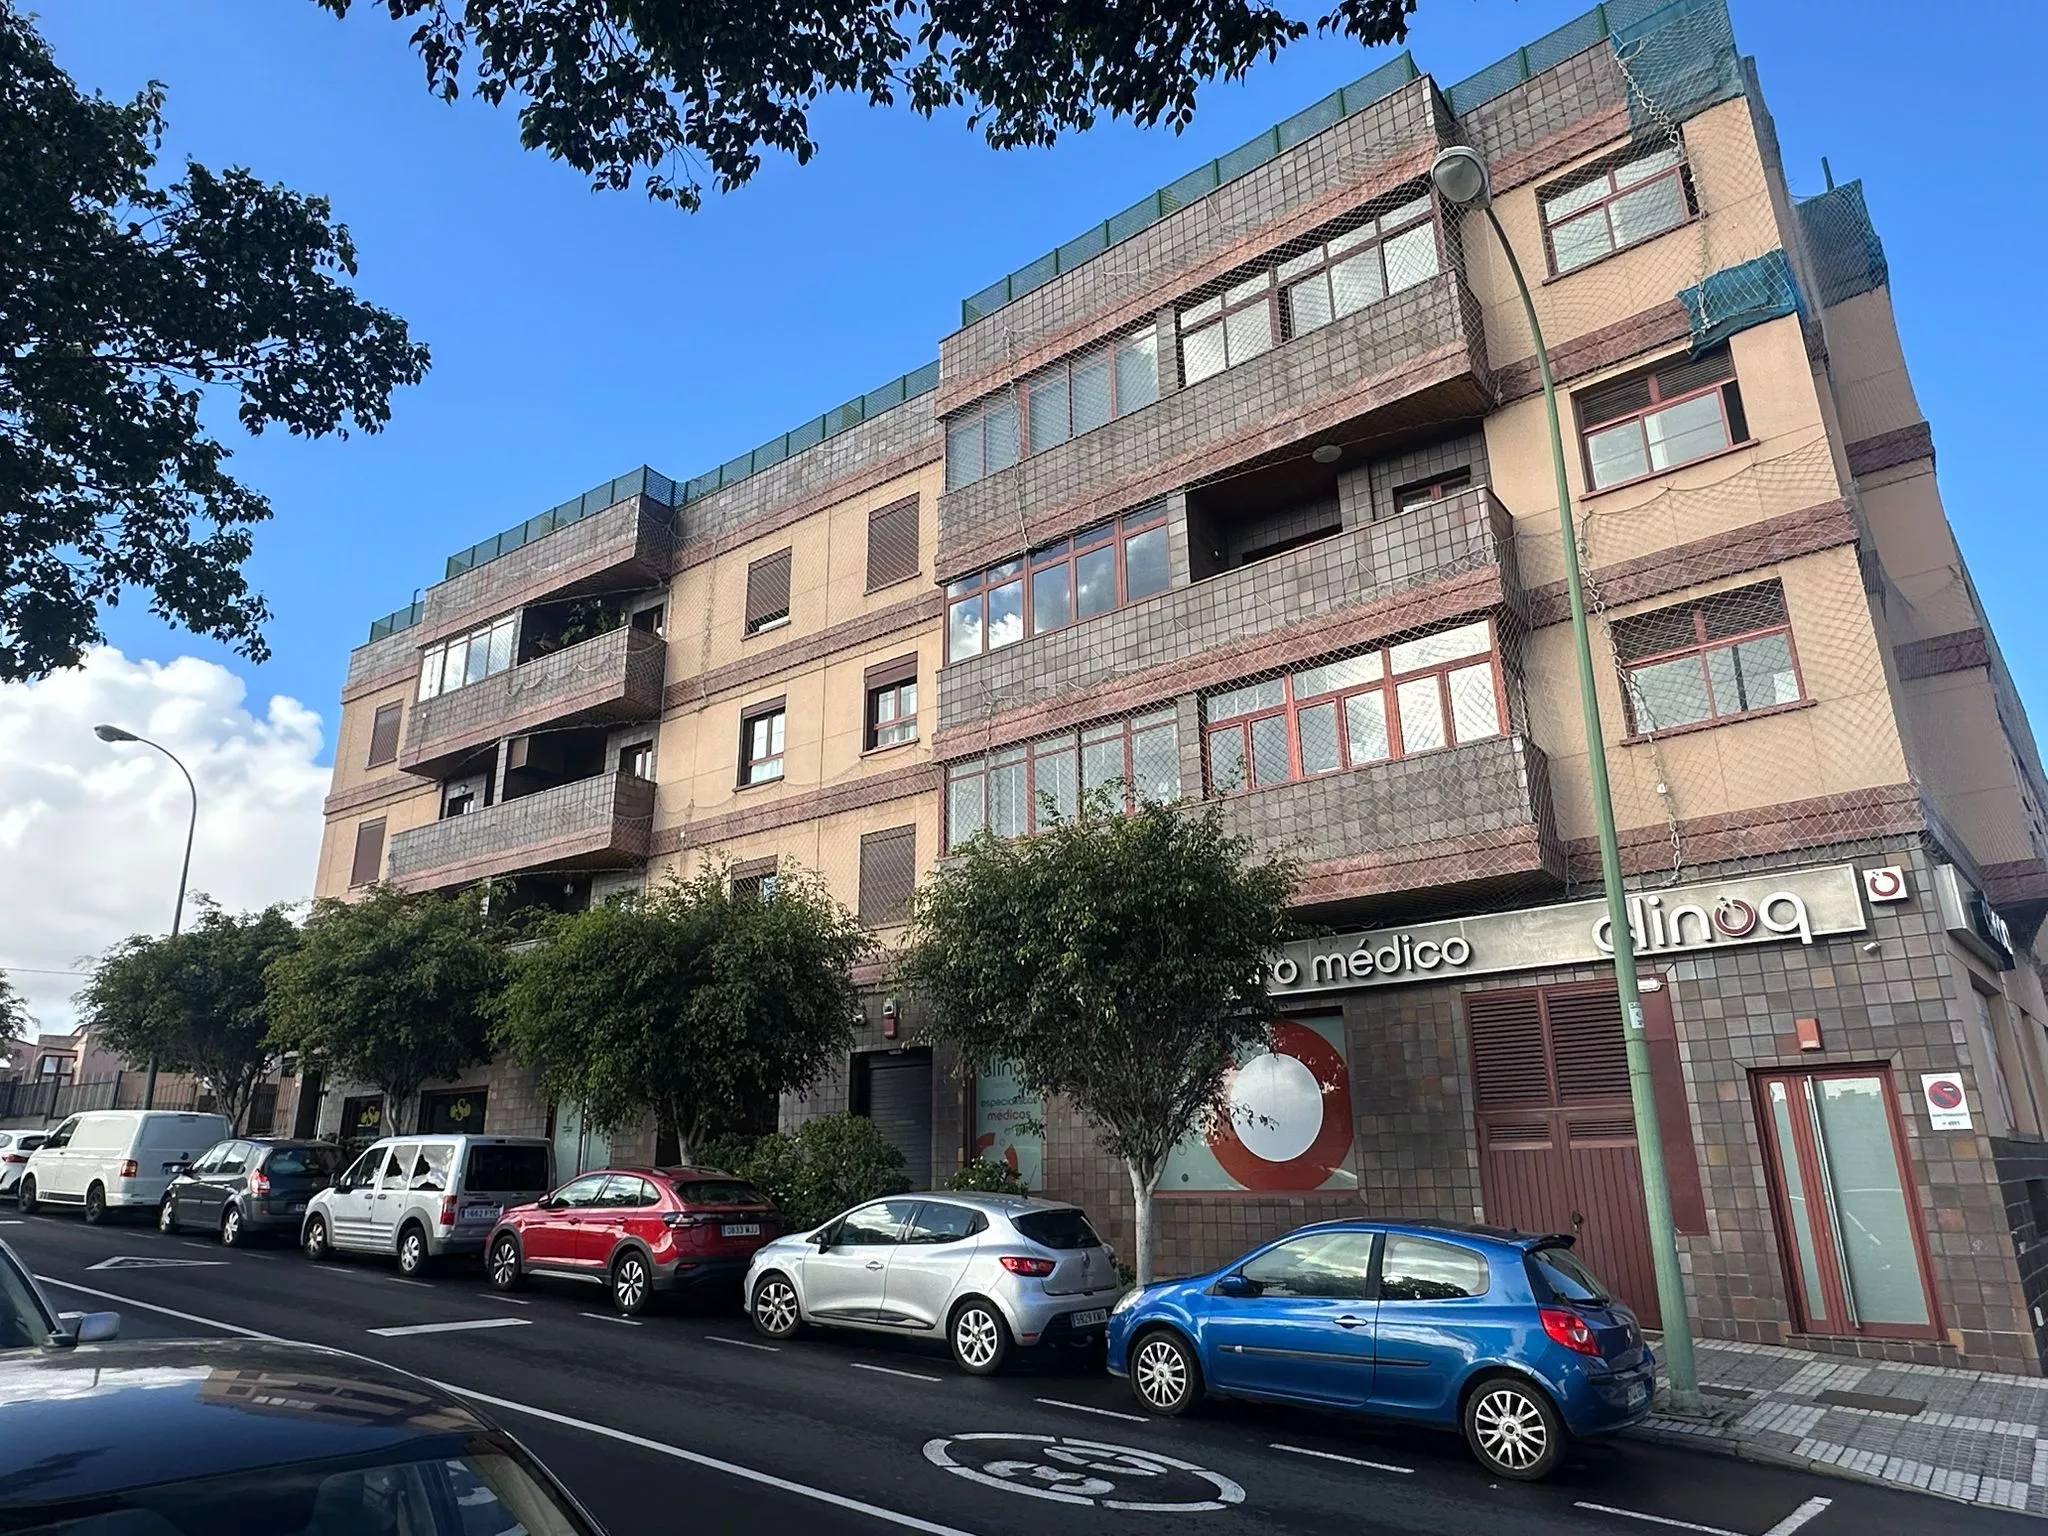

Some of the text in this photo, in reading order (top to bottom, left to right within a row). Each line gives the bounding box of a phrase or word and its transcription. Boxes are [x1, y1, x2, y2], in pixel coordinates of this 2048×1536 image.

[1591, 891, 1813, 945] clinoq
[1312, 934, 1471, 982] médico
[987, 1108, 1032, 1120] médicos
[981, 1445, 1168, 1495] 30
